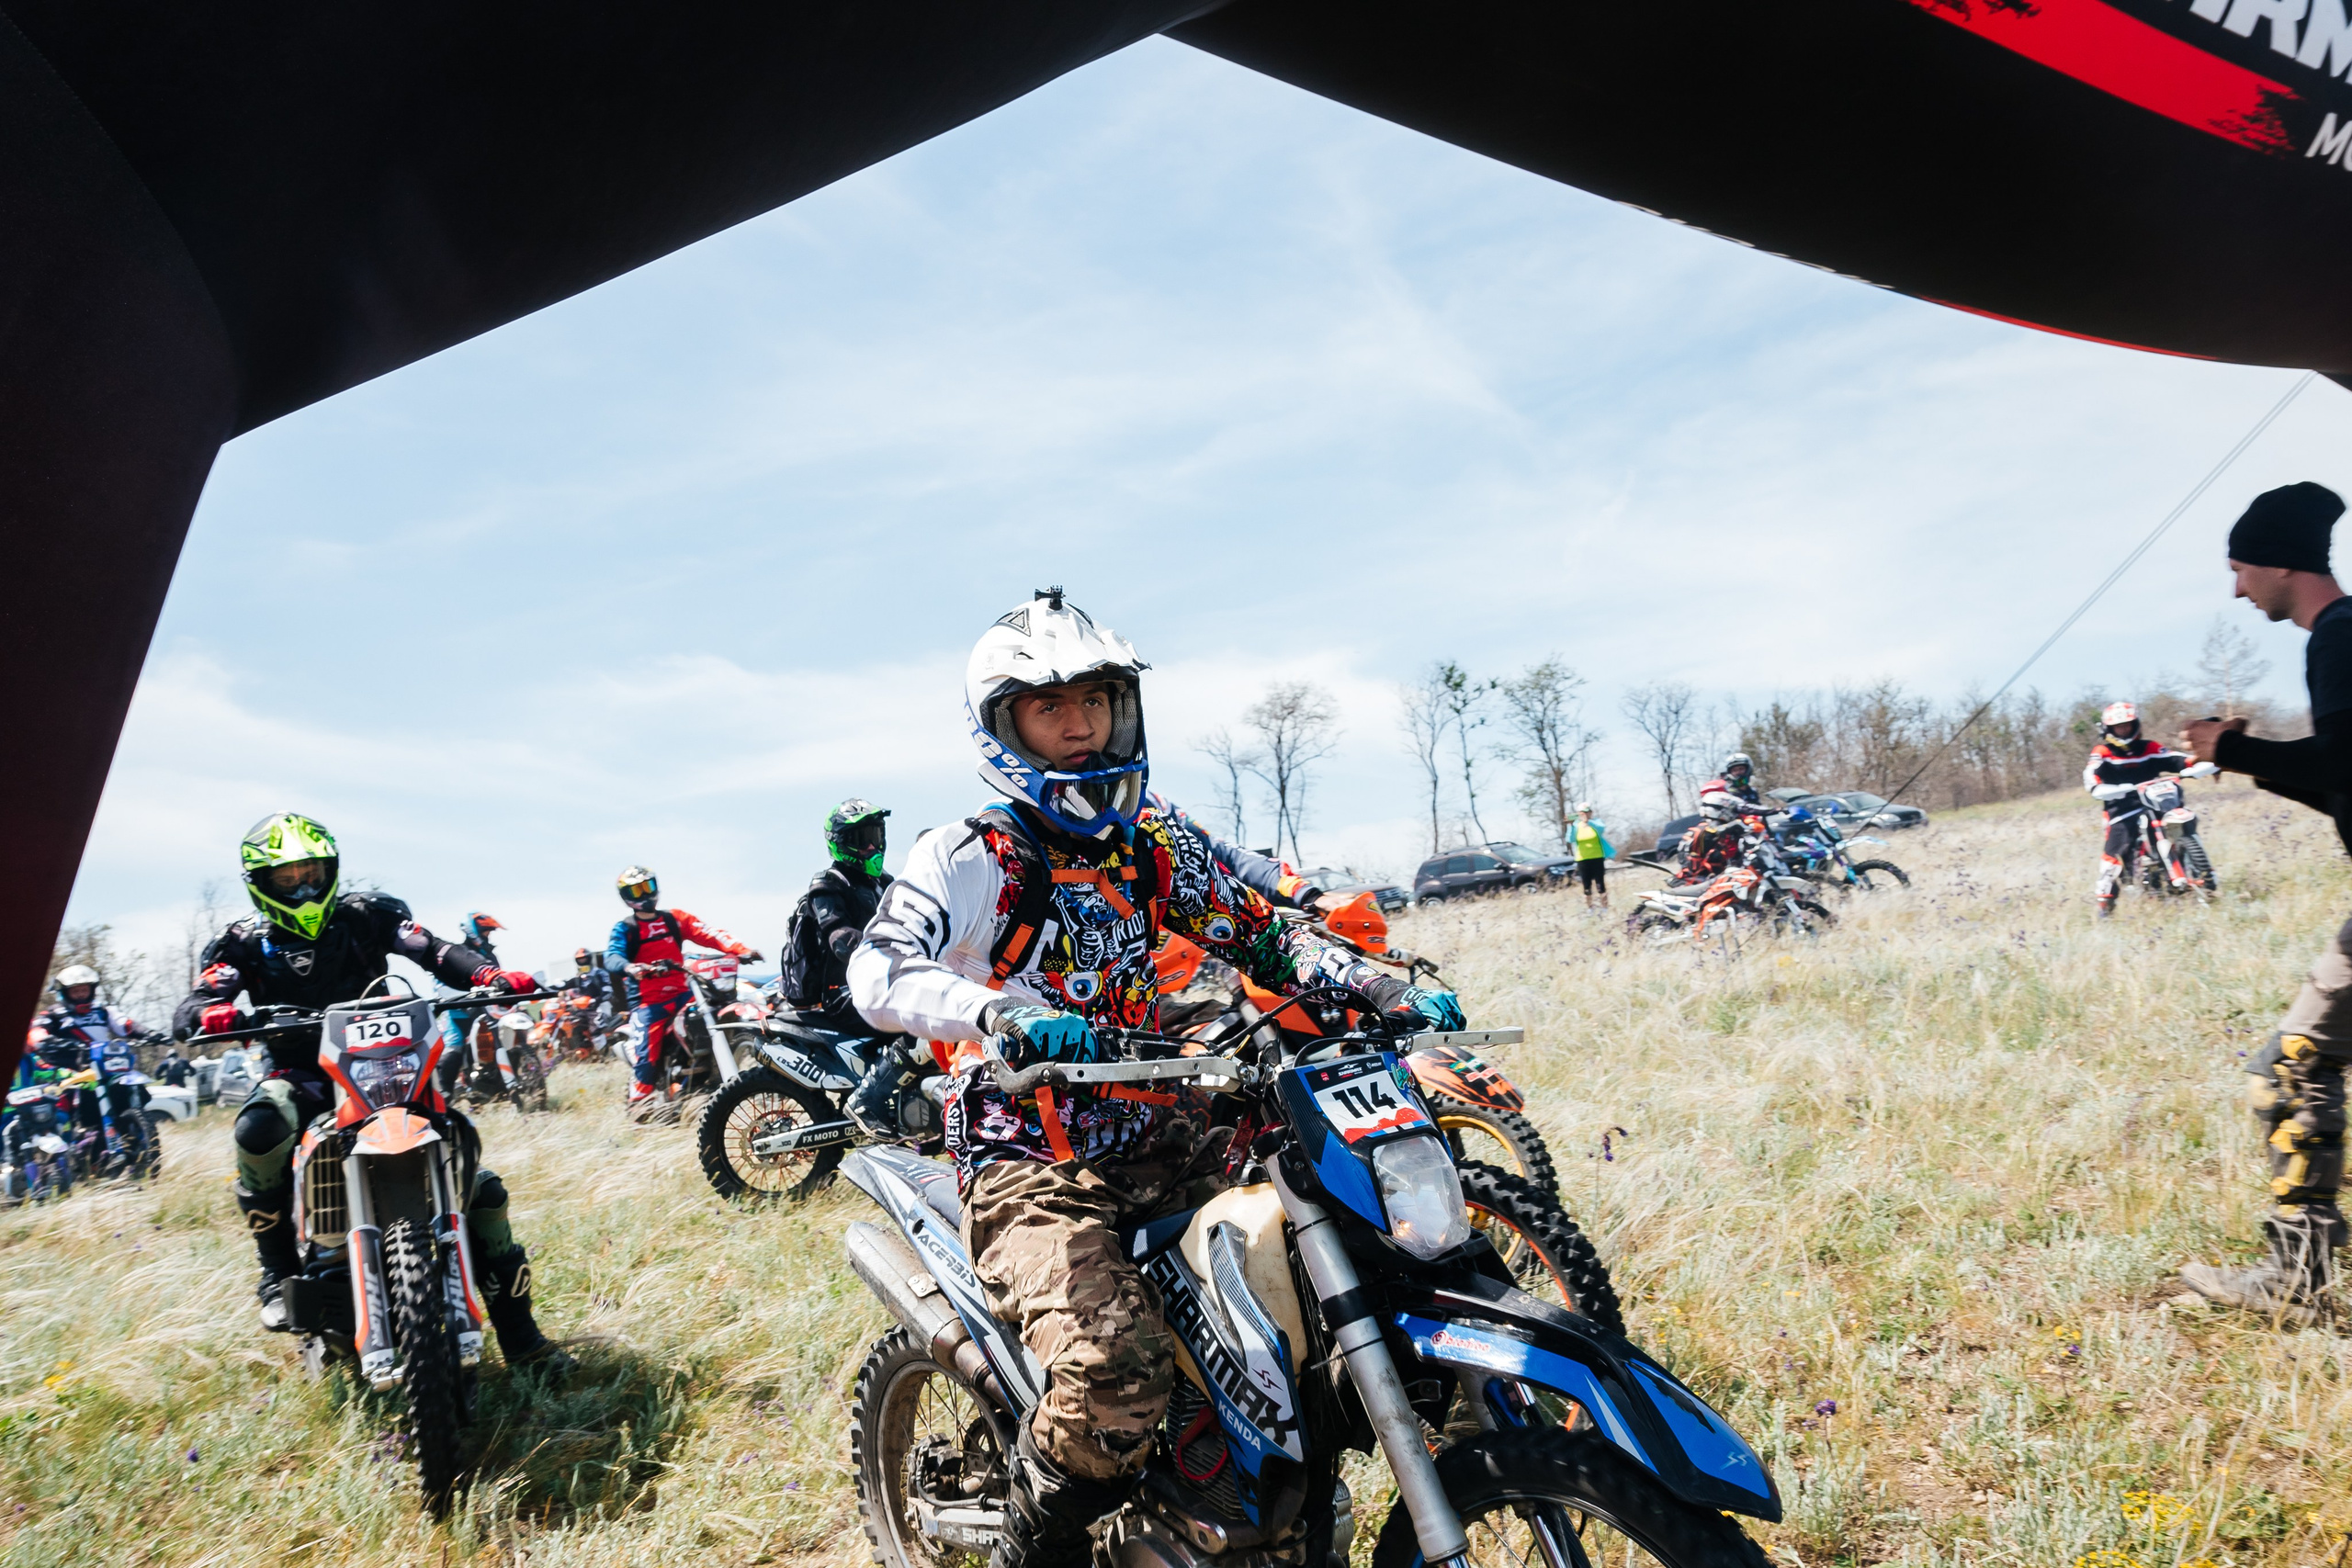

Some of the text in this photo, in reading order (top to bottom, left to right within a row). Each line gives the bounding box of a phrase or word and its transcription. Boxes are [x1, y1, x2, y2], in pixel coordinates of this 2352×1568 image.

[2304, 112, 2352, 172] M
[356, 1021, 401, 1041] 120
[789, 1055, 824, 1084] 300
[1331, 1080, 1398, 1120] 114
[802, 1130, 840, 1144] FX MOTO
[1148, 1254, 1298, 1449] SHARMAX
[1217, 1399, 1261, 1451] KENDA
